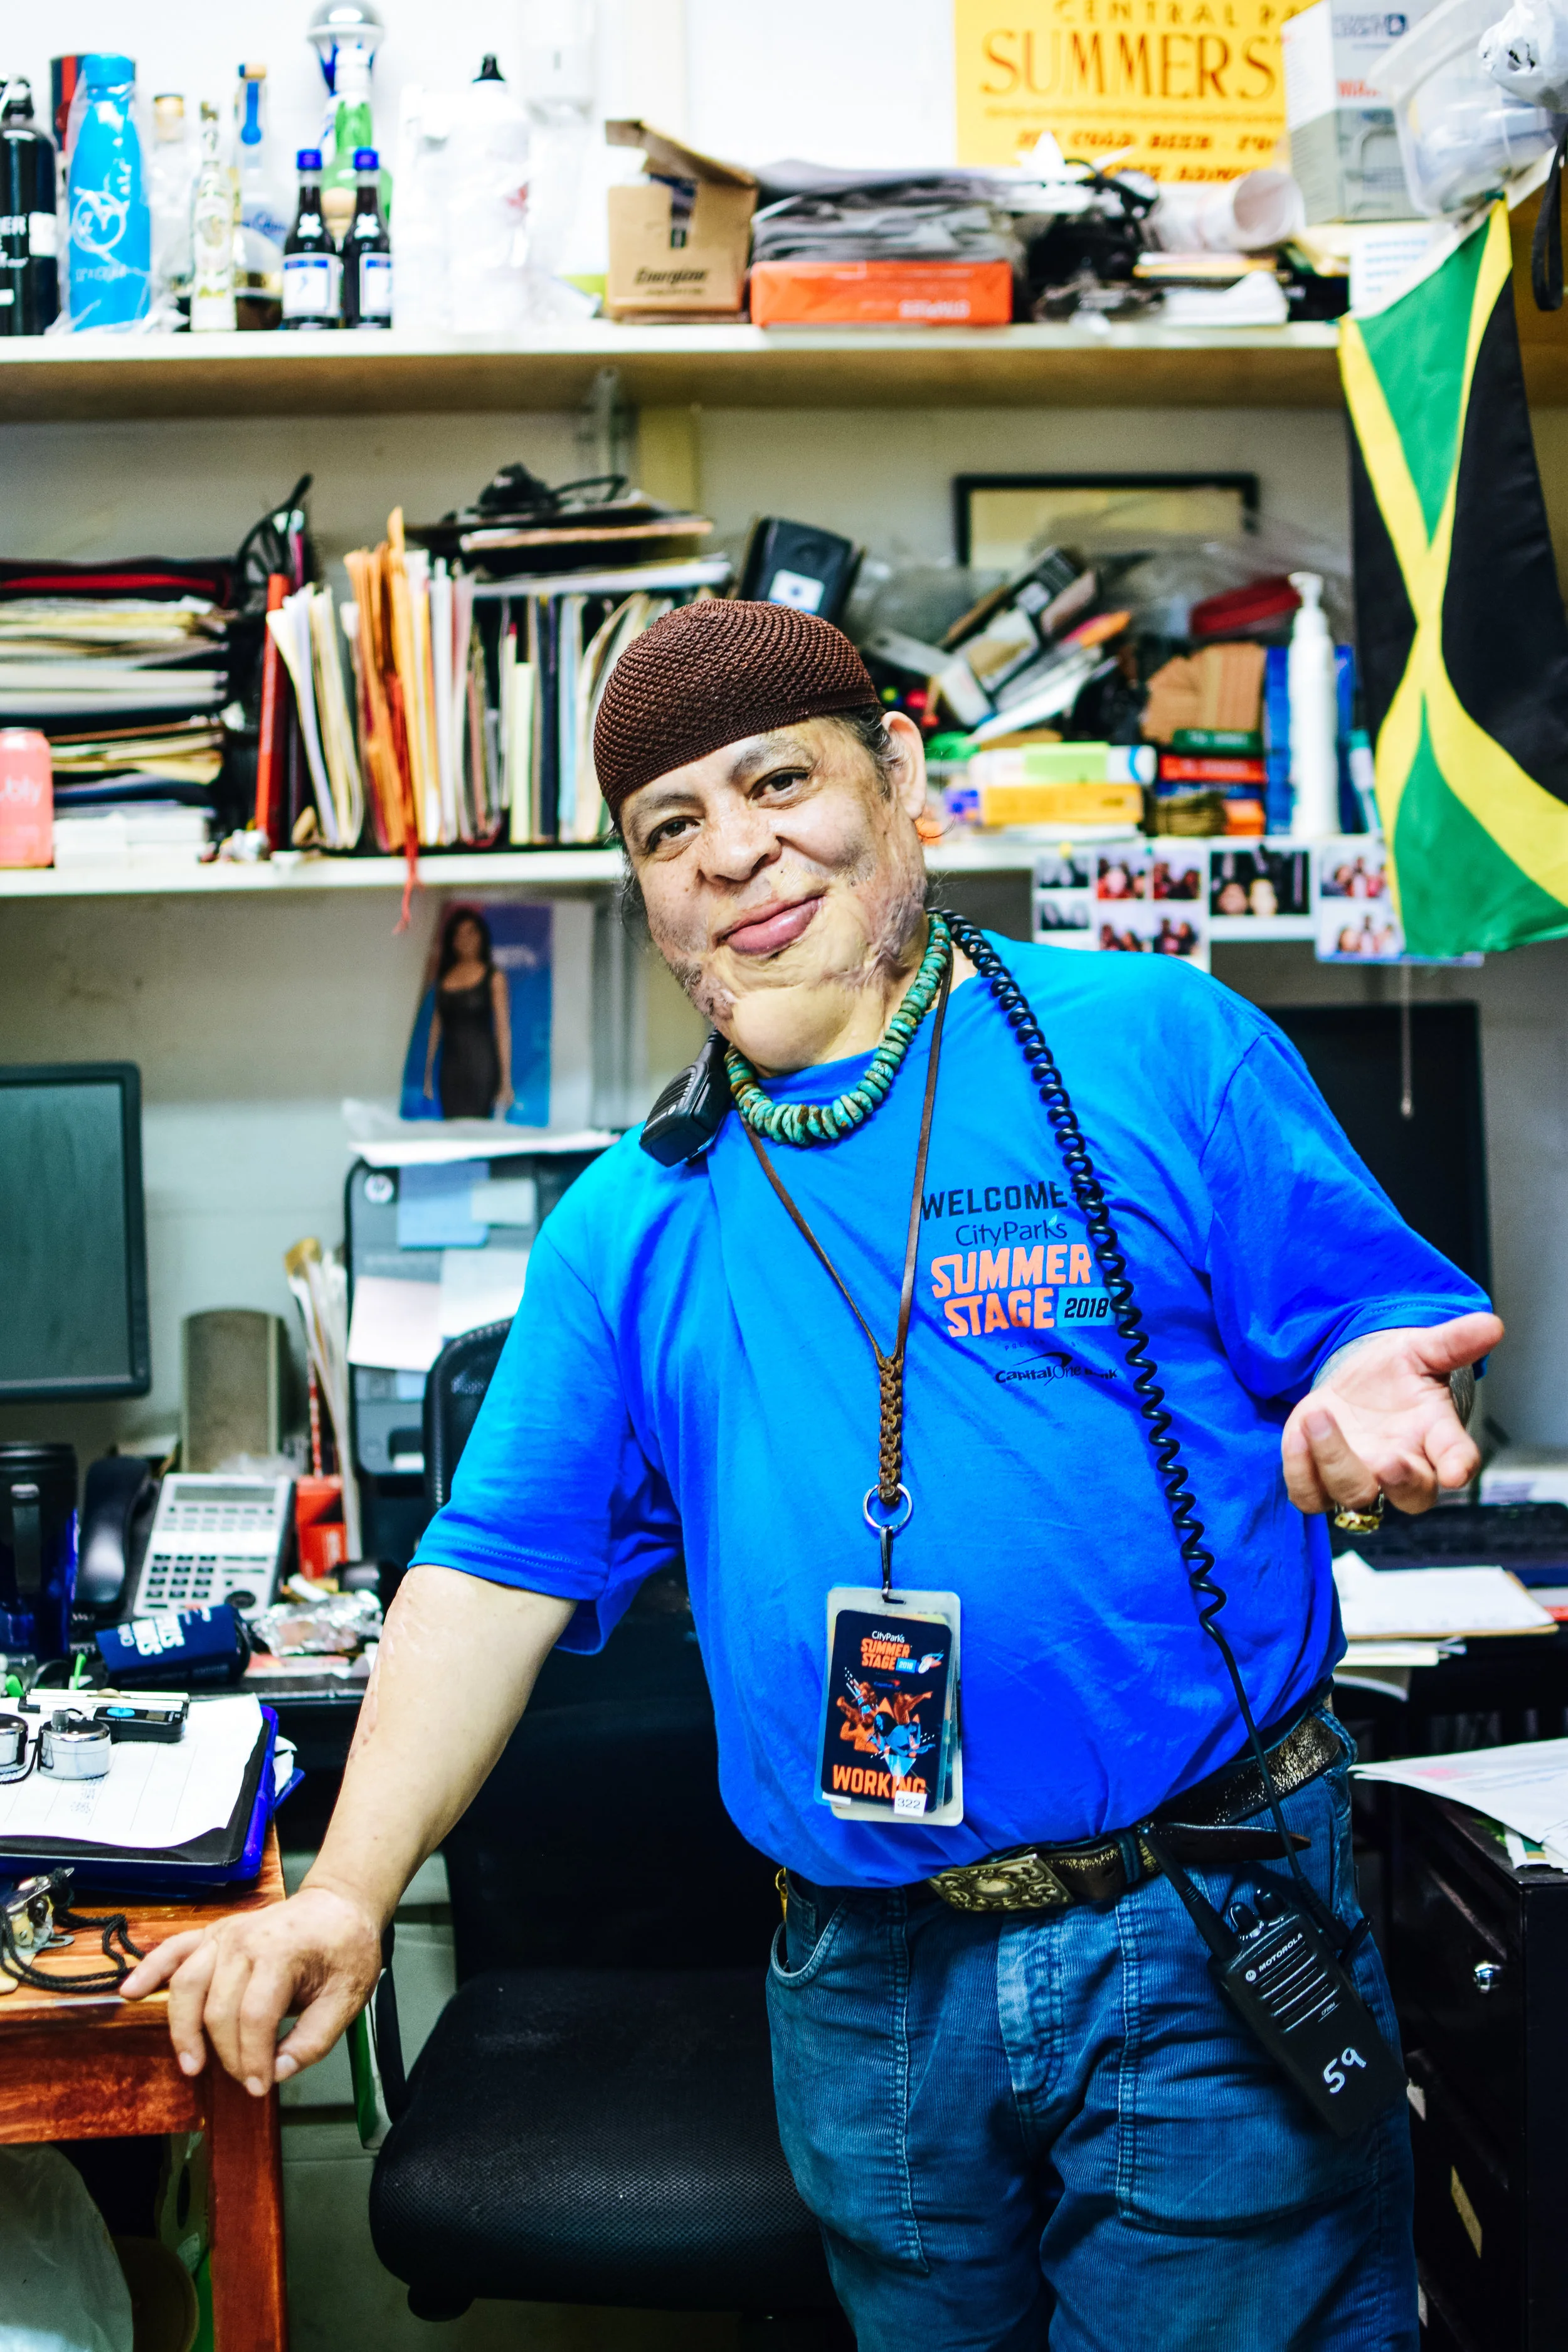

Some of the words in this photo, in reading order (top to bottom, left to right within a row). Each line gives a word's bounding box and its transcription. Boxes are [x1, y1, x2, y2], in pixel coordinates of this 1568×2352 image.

[980, 29, 1281, 102] SUMMERS
[921, 1181, 1067, 1221] WELCOME
[955, 1215, 1067, 1247] CityParks
[931, 1244, 1092, 1298] SUMMER
[944, 1288, 1055, 1338] STAGE
[1064, 1297, 1110, 1318] 2018
[861, 1638, 911, 1659] SUMMER
[872, 1630, 905, 1643] CityParks
[861, 1652, 897, 1671] STAGE
[898, 1660, 913, 1670] 2018
[897, 1798, 921, 1809] 322
[1259, 1932, 1303, 1972] MOTOROLA
[1323, 2047, 1367, 2094] 59
